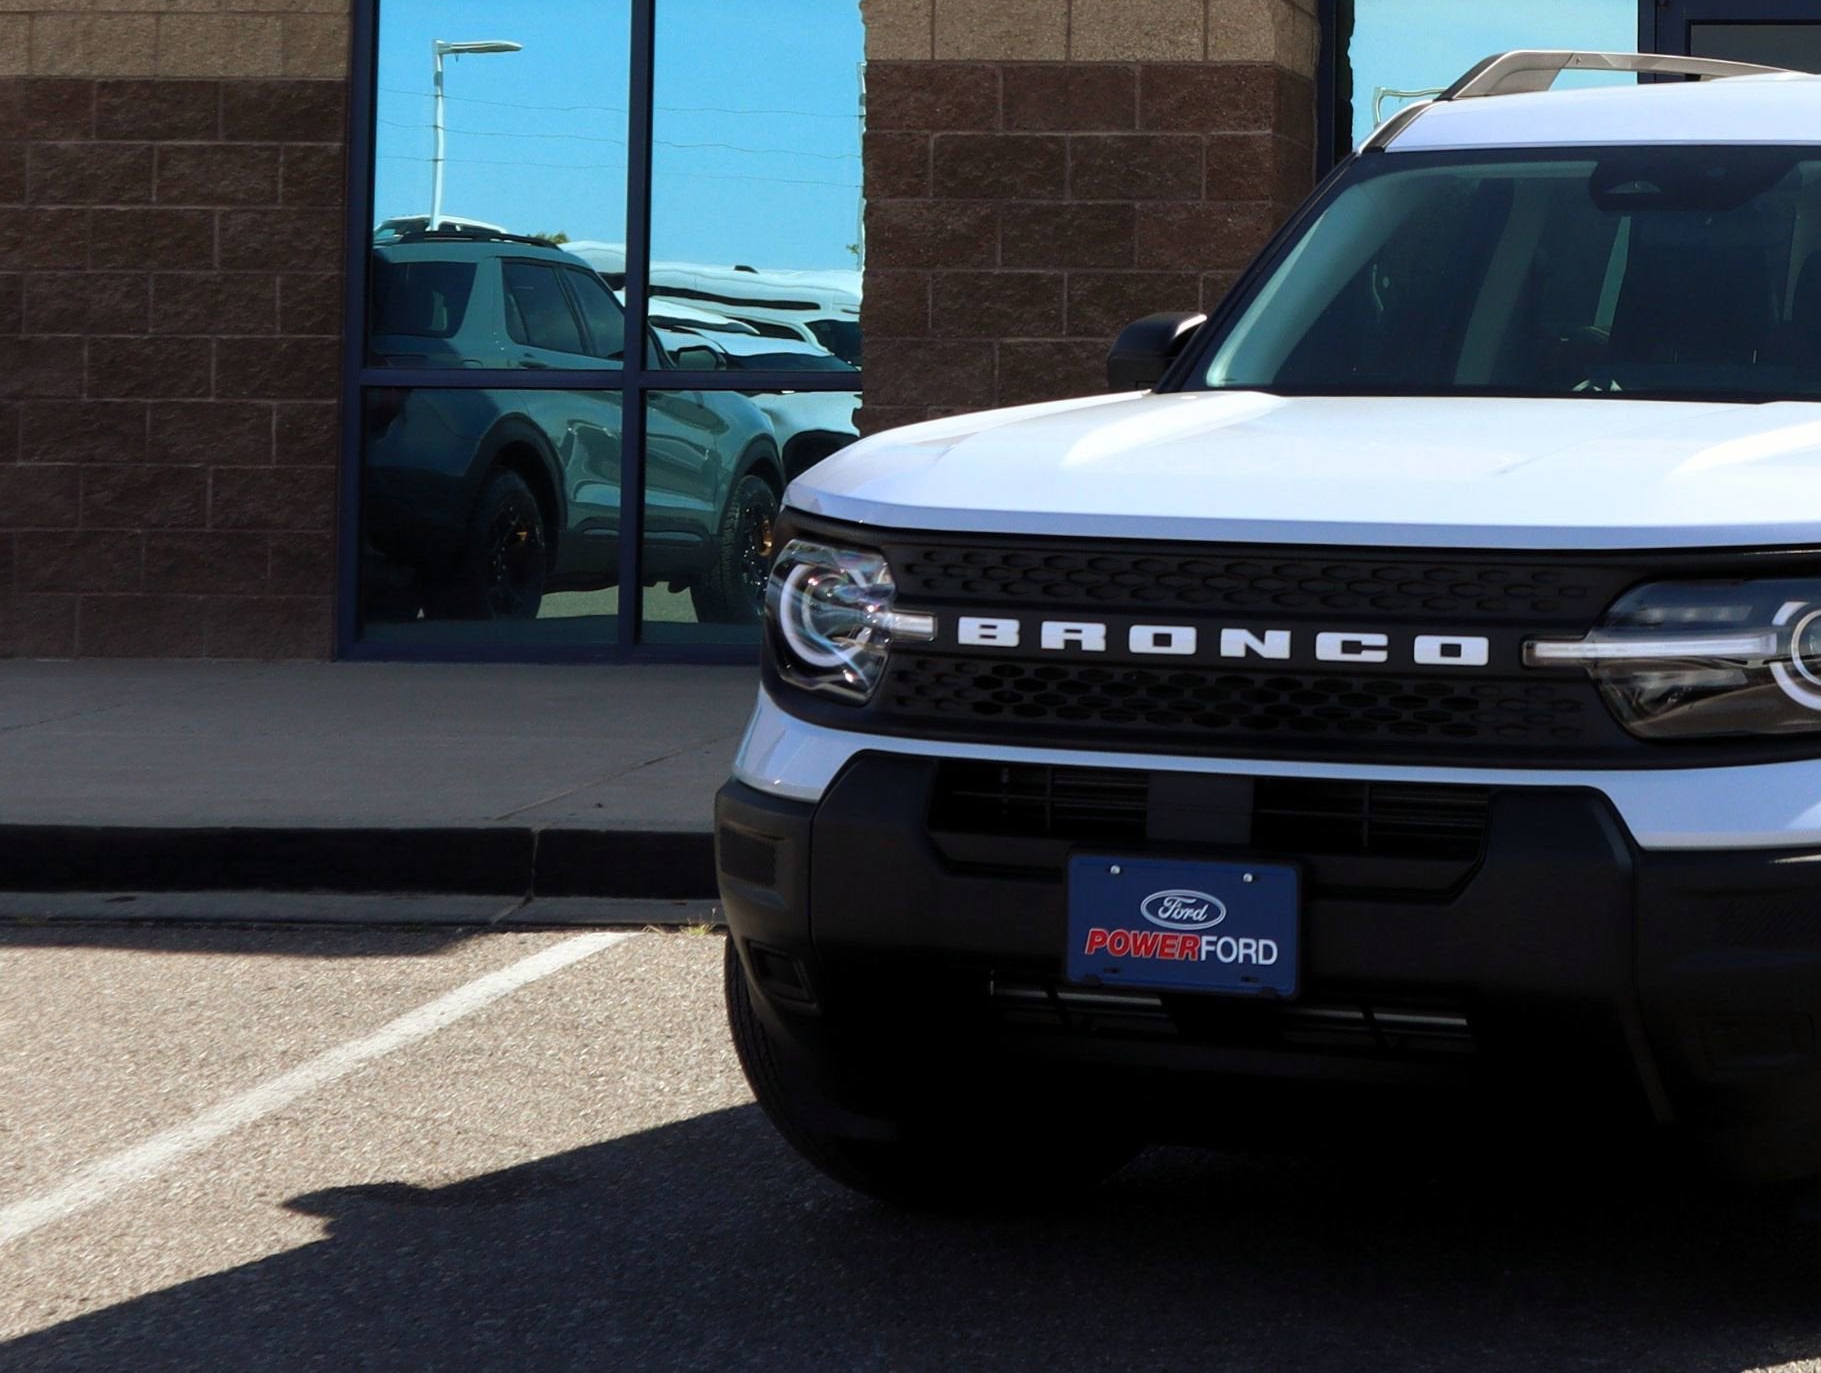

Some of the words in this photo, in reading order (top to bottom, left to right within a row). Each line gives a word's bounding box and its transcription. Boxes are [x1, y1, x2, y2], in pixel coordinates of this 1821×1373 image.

[957, 616, 1490, 666] BRONCO
[1157, 896, 1209, 922] Ford
[1084, 928, 1279, 966] POWERFORD
